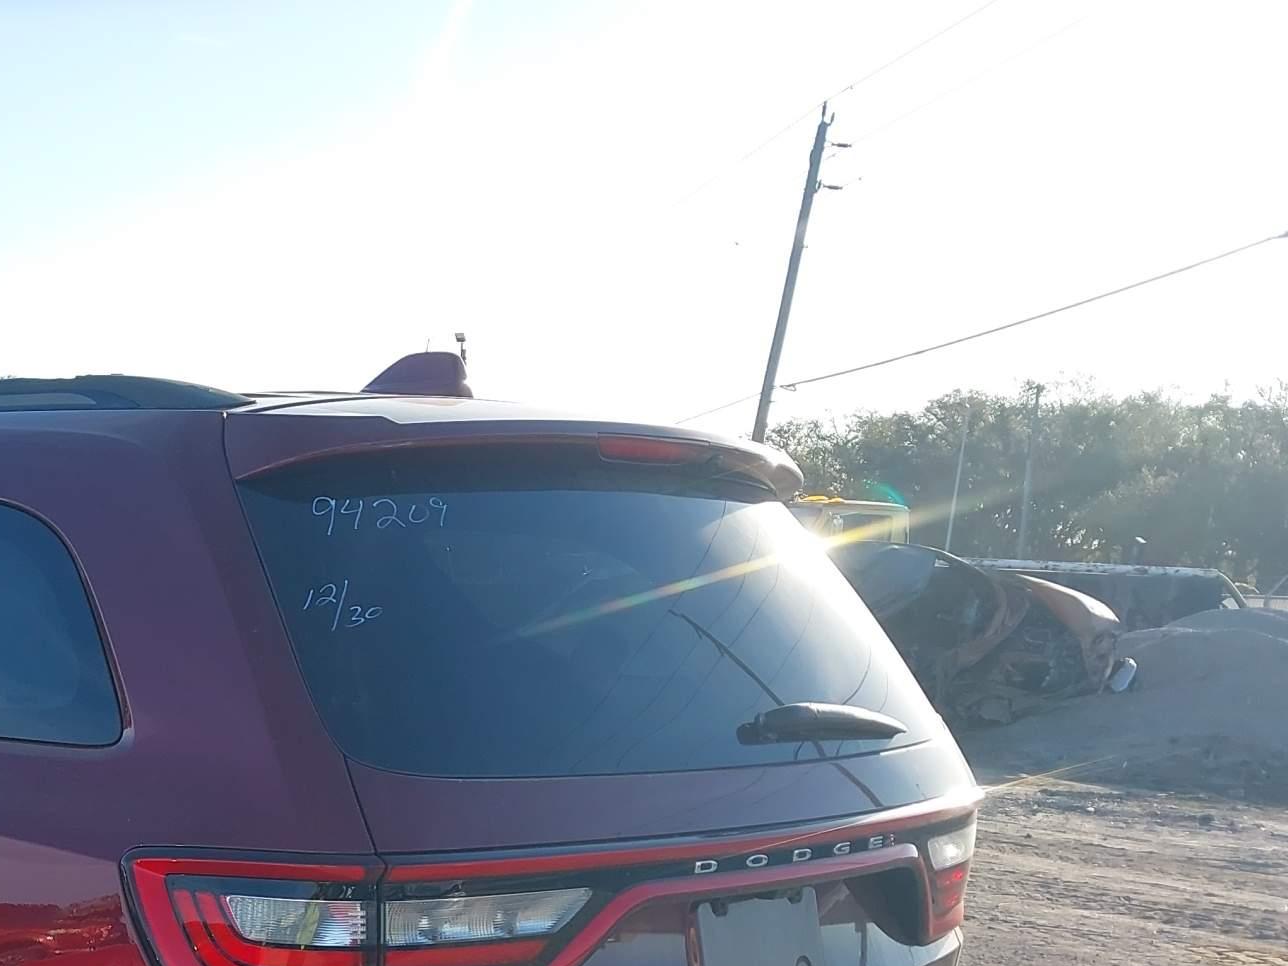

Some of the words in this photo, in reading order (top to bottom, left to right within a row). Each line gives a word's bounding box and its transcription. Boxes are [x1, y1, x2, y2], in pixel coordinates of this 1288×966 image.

[312, 496, 448, 536] 94209
[303, 579, 383, 632] 12/30
[694, 835, 884, 874] DODGE
